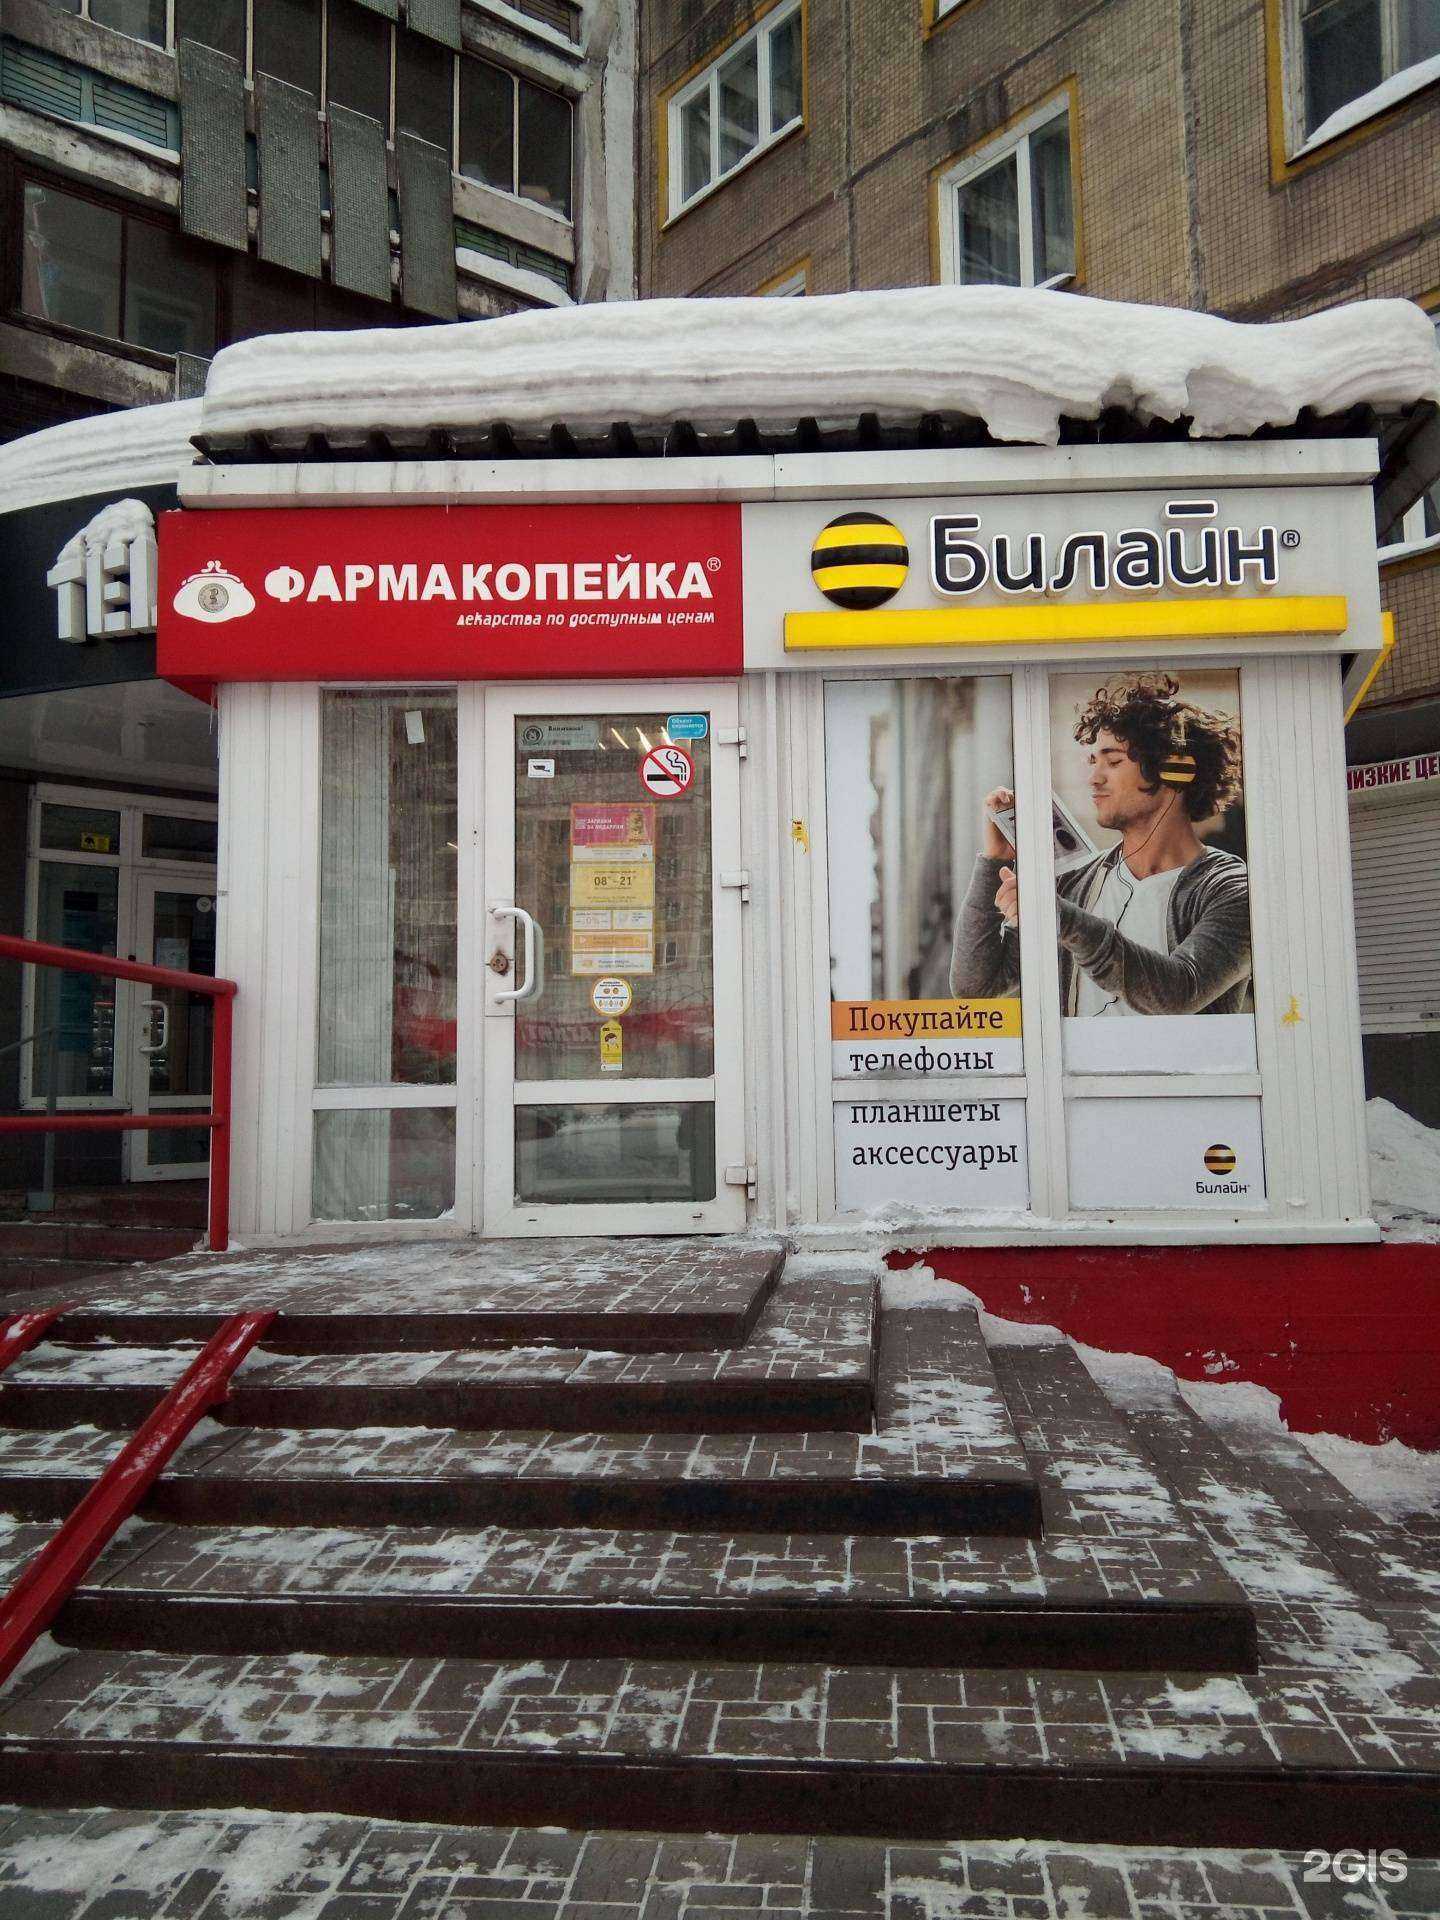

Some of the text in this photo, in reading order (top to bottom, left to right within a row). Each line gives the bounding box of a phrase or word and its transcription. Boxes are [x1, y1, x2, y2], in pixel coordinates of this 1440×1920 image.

[456, 611, 715, 628] лекарства по доступным ценам
[1415, 755, 1440, 780] ЦЕ
[849, 1005, 1004, 1037] Покупайте
[850, 1046, 995, 1073] телефоны
[851, 1103, 1001, 1124] планшеты
[852, 1144, 1019, 1171] аксессуары
[1195, 1181, 1248, 1194] Билайн
